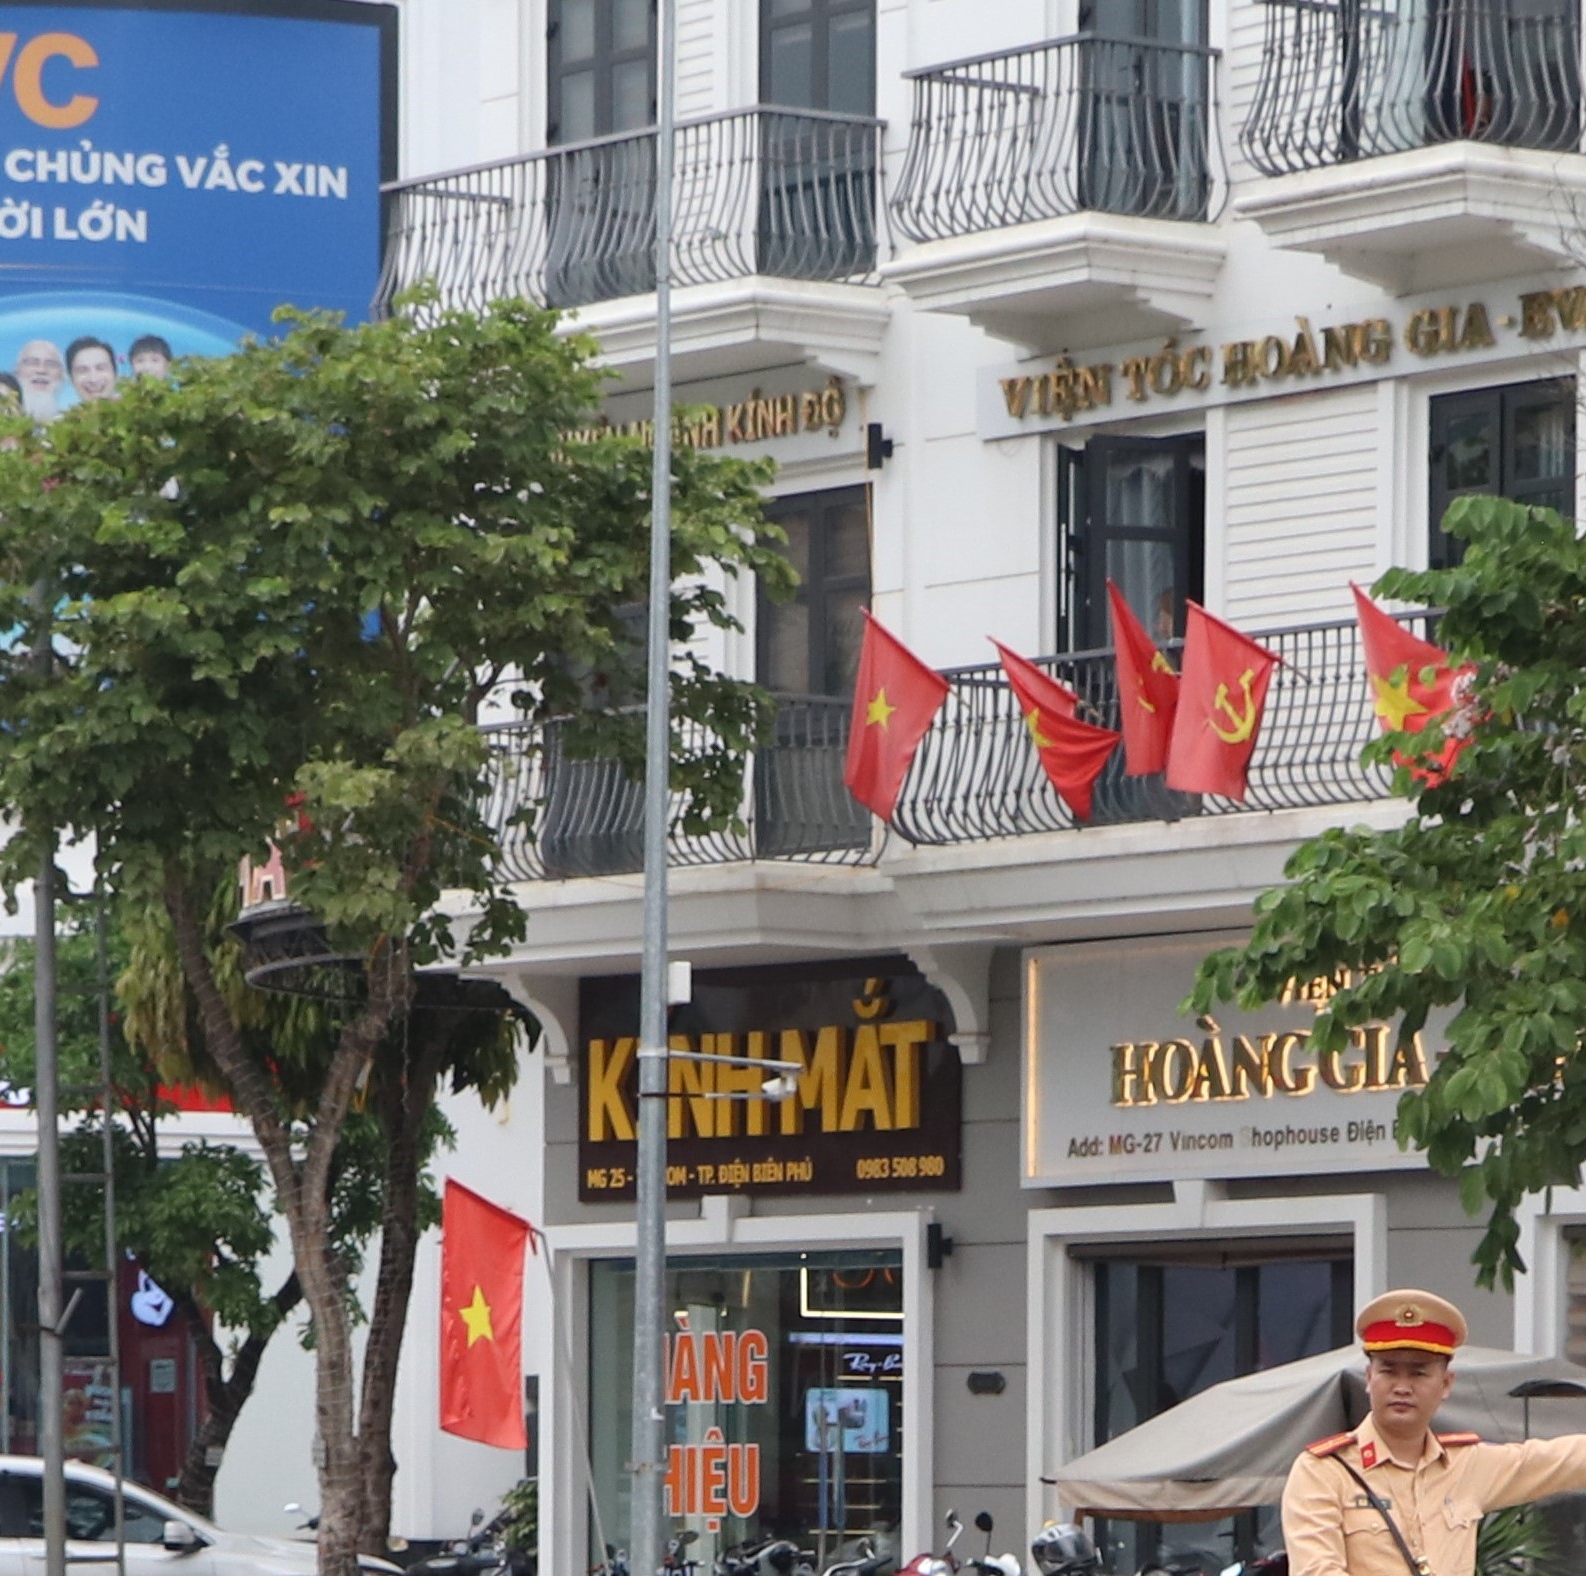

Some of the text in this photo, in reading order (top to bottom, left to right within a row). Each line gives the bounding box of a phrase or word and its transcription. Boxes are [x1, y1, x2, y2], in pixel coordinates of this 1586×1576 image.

[4, 140, 166, 188] CHỦNG
[175, 142, 265, 195] VẮC
[275, 162, 349, 198] XIN
[53, 199, 148, 244] LỚN
[999, 348, 1113, 421] VIỆN
[1120, 337, 1211, 401] TÓC
[1220, 316, 1391, 388] HOÀNG
[1405, 302, 1495, 355] GIA
[727, 388, 796, 443] KÍNH
[801, 376, 845, 438] ĐỘ
[588, 977, 936, 1142] KNH MẮT
[1111, 1013, 1430, 1107] HOÀNG GIA
[1068, 1136, 1104, 1158] Add:
[1108, 1132, 1163, 1156] MG-27
[1170, 1130, 1234, 1151] Vincom
[1347, 1119, 1386, 1147] Điện
[587, 1168, 608, 1190] MG
[610, 1166, 626, 1188] 25
[718, 1157, 752, 1189] ĐIỆN
[753, 1156, 784, 1182] BIÊN
[786, 1155, 814, 1181] PHỦ
[663, 1316, 769, 1404] ÀNG
